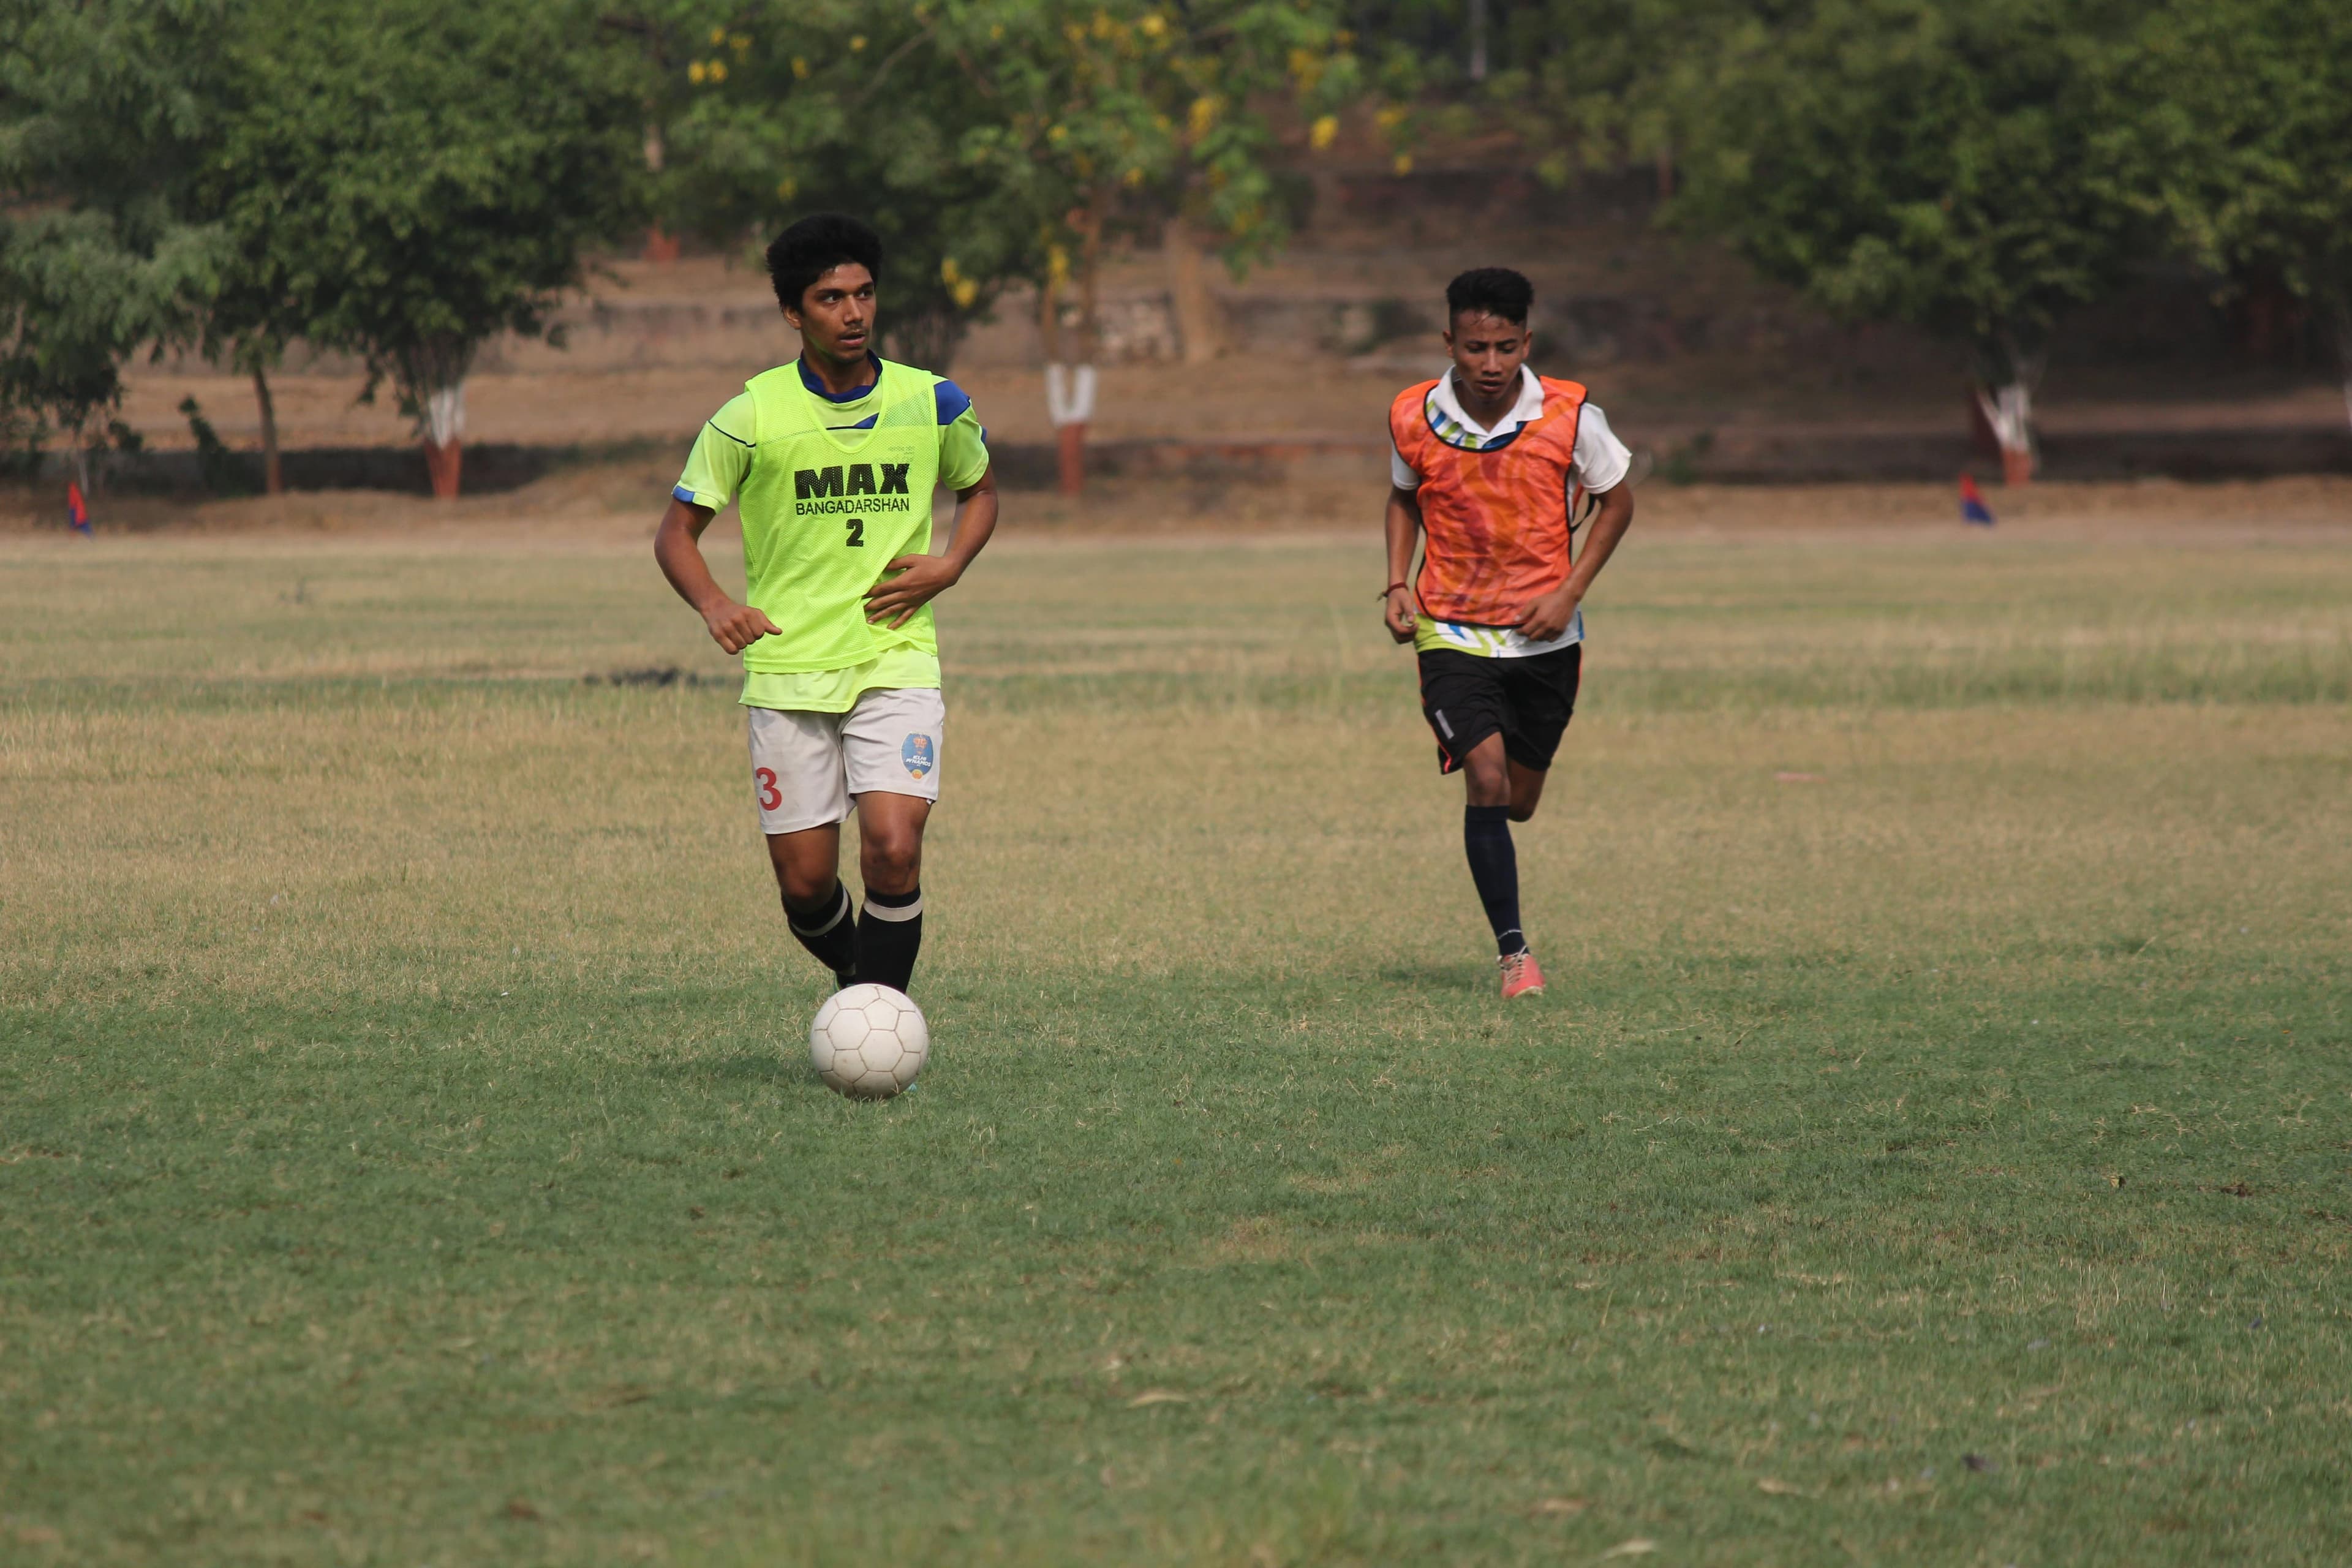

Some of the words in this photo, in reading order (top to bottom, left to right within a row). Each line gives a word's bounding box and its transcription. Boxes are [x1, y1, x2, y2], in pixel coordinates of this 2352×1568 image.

[794, 464, 910, 499] MAX
[796, 498, 910, 515] BANGADARSHAN
[846, 519, 864, 546] 2
[756, 767, 782, 811] 3
